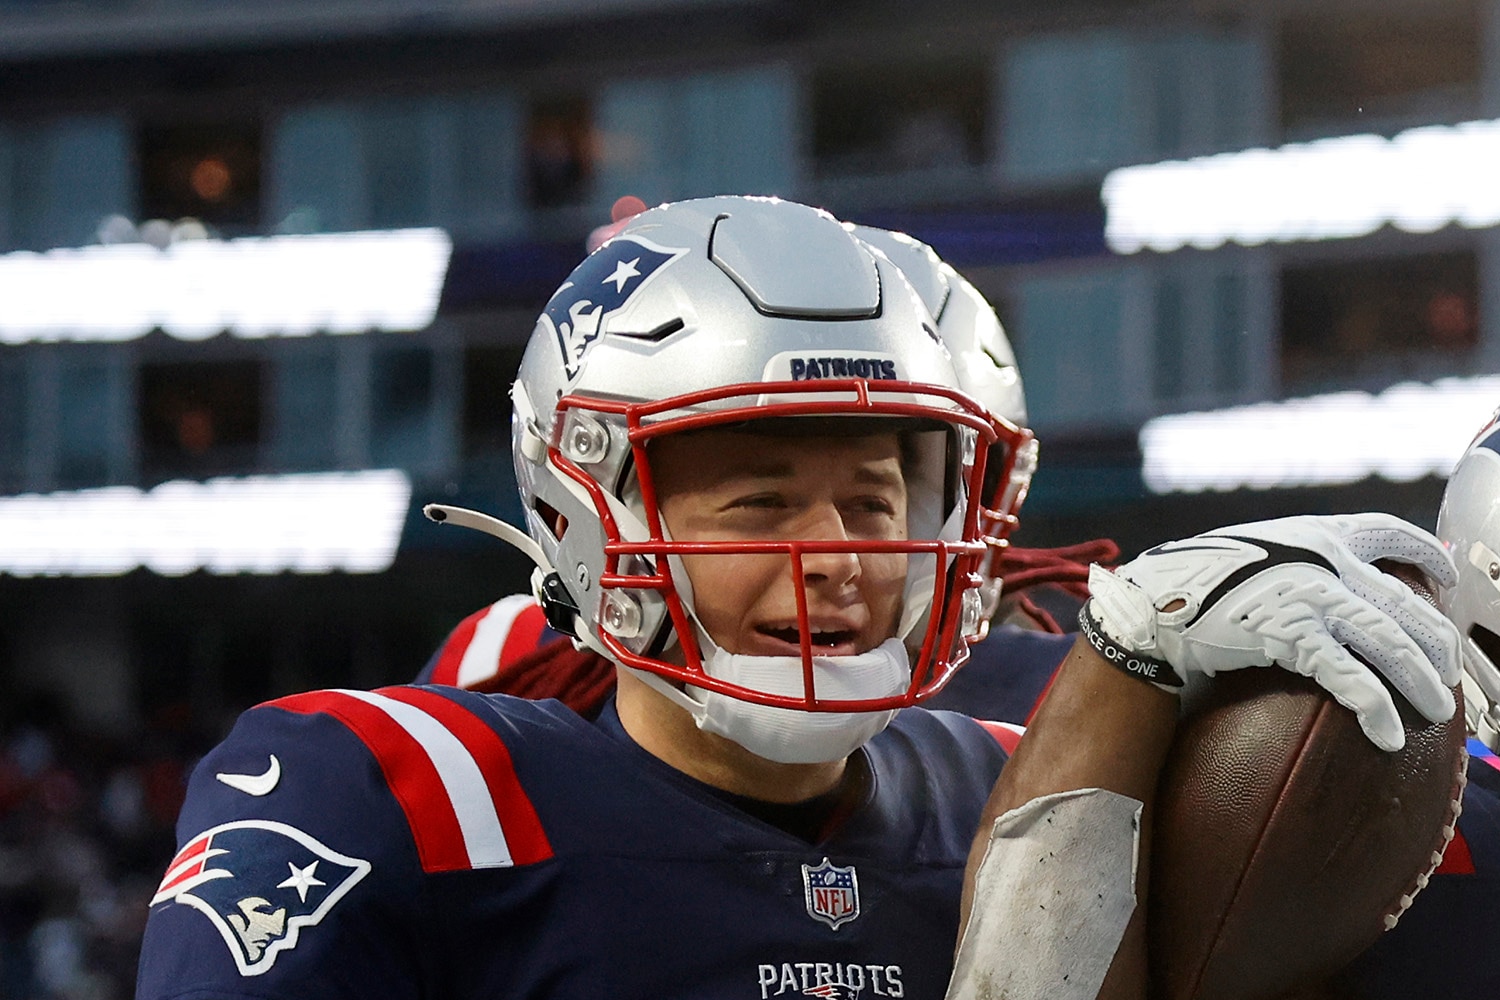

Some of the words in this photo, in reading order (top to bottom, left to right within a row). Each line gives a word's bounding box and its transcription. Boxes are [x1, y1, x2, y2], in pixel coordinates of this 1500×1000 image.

[789, 357, 897, 381] PATRIOTS
[1104, 645, 1126, 663] OF
[1126, 659, 1159, 678] ONE
[814, 888, 853, 917] NFL
[757, 962, 905, 1000] PATRIOTS
